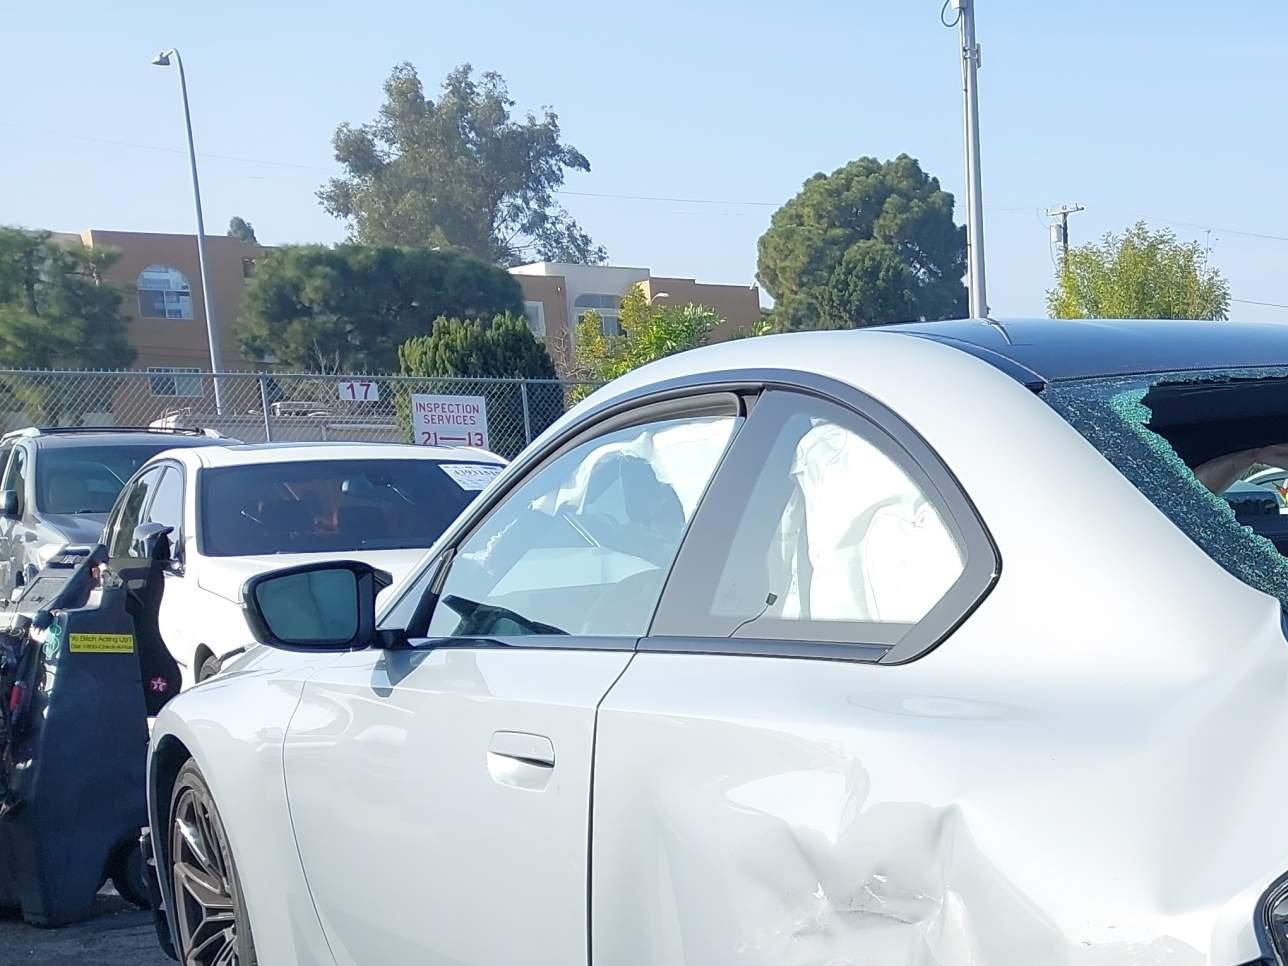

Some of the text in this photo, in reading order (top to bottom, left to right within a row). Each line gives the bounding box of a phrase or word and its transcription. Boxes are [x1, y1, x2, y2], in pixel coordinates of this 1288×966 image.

[346, 383, 371, 400] 17
[415, 402, 480, 415] INSPECTION
[423, 414, 476, 426] SERVICES
